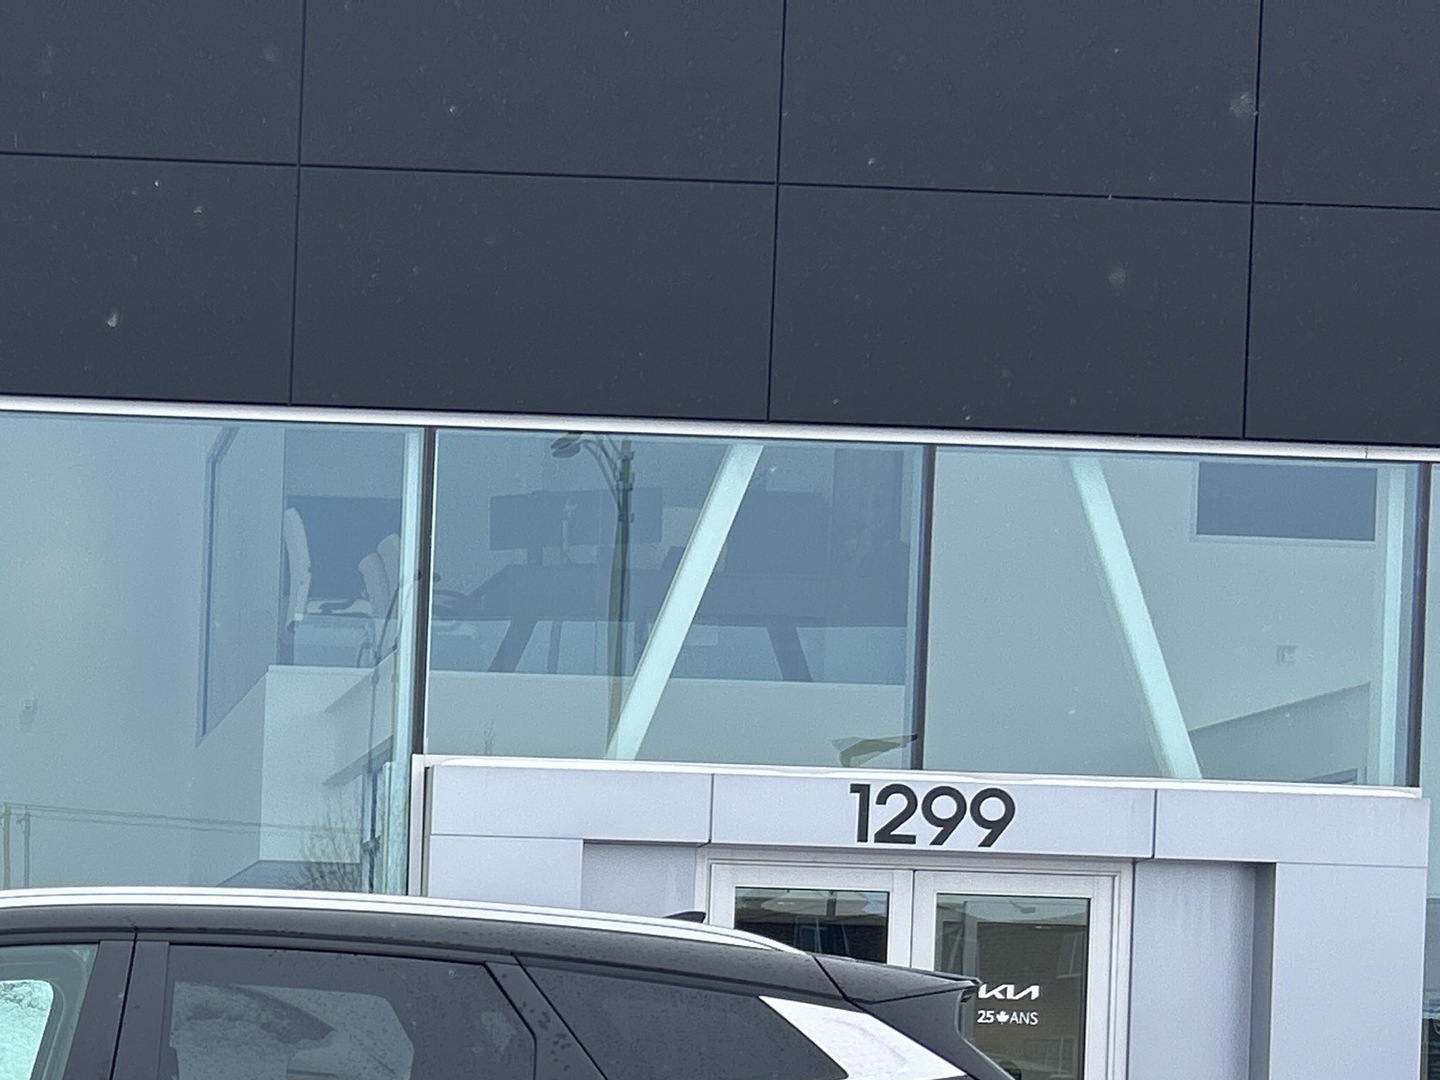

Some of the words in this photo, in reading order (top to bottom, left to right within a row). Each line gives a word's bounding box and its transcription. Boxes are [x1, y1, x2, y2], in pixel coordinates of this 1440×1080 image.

[849, 783, 1016, 848] 1299
[978, 983, 1040, 1001] KIA
[977, 1009, 995, 1023] 25
[1009, 1011, 1039, 1026] ANS
